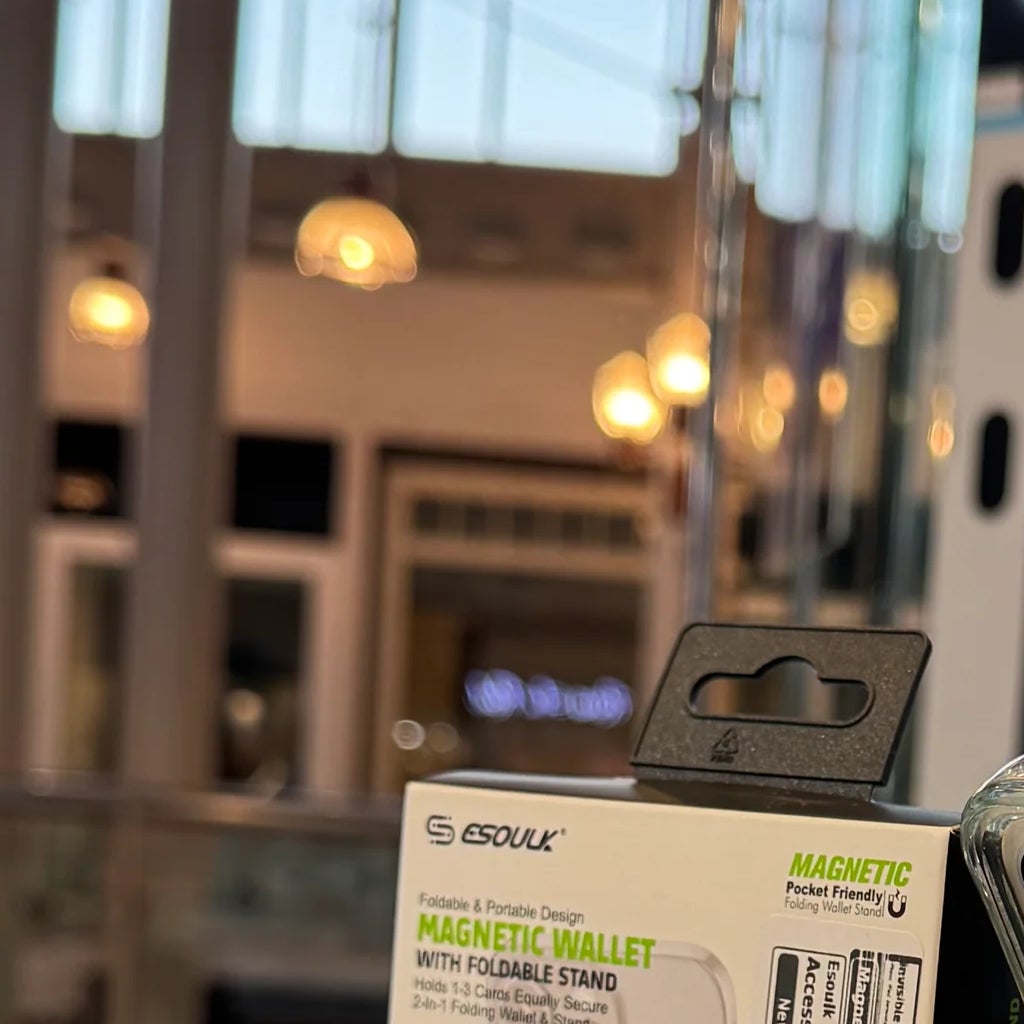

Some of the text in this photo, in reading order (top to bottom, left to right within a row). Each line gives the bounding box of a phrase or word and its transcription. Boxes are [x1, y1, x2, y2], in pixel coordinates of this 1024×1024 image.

[788, 852, 912, 887] MAGNETIC
[418, 892, 585, 926] Foldable & Portable Design
[784, 896, 882, 918] Folding Wallet Stand
[786, 881, 883, 906] Pocket Friendly
[417, 913, 656, 969] MAGNETIC WALLET
[416, 949, 617, 992] WITH FOLDABLE STAND
[413, 978, 608, 1014] Holds 1-3 Cards Equally Secure
[823, 960, 840, 1019] Esoulk
[451, 1002, 495, 1022] Folding
[500, 1007, 537, 1024] Wallet
